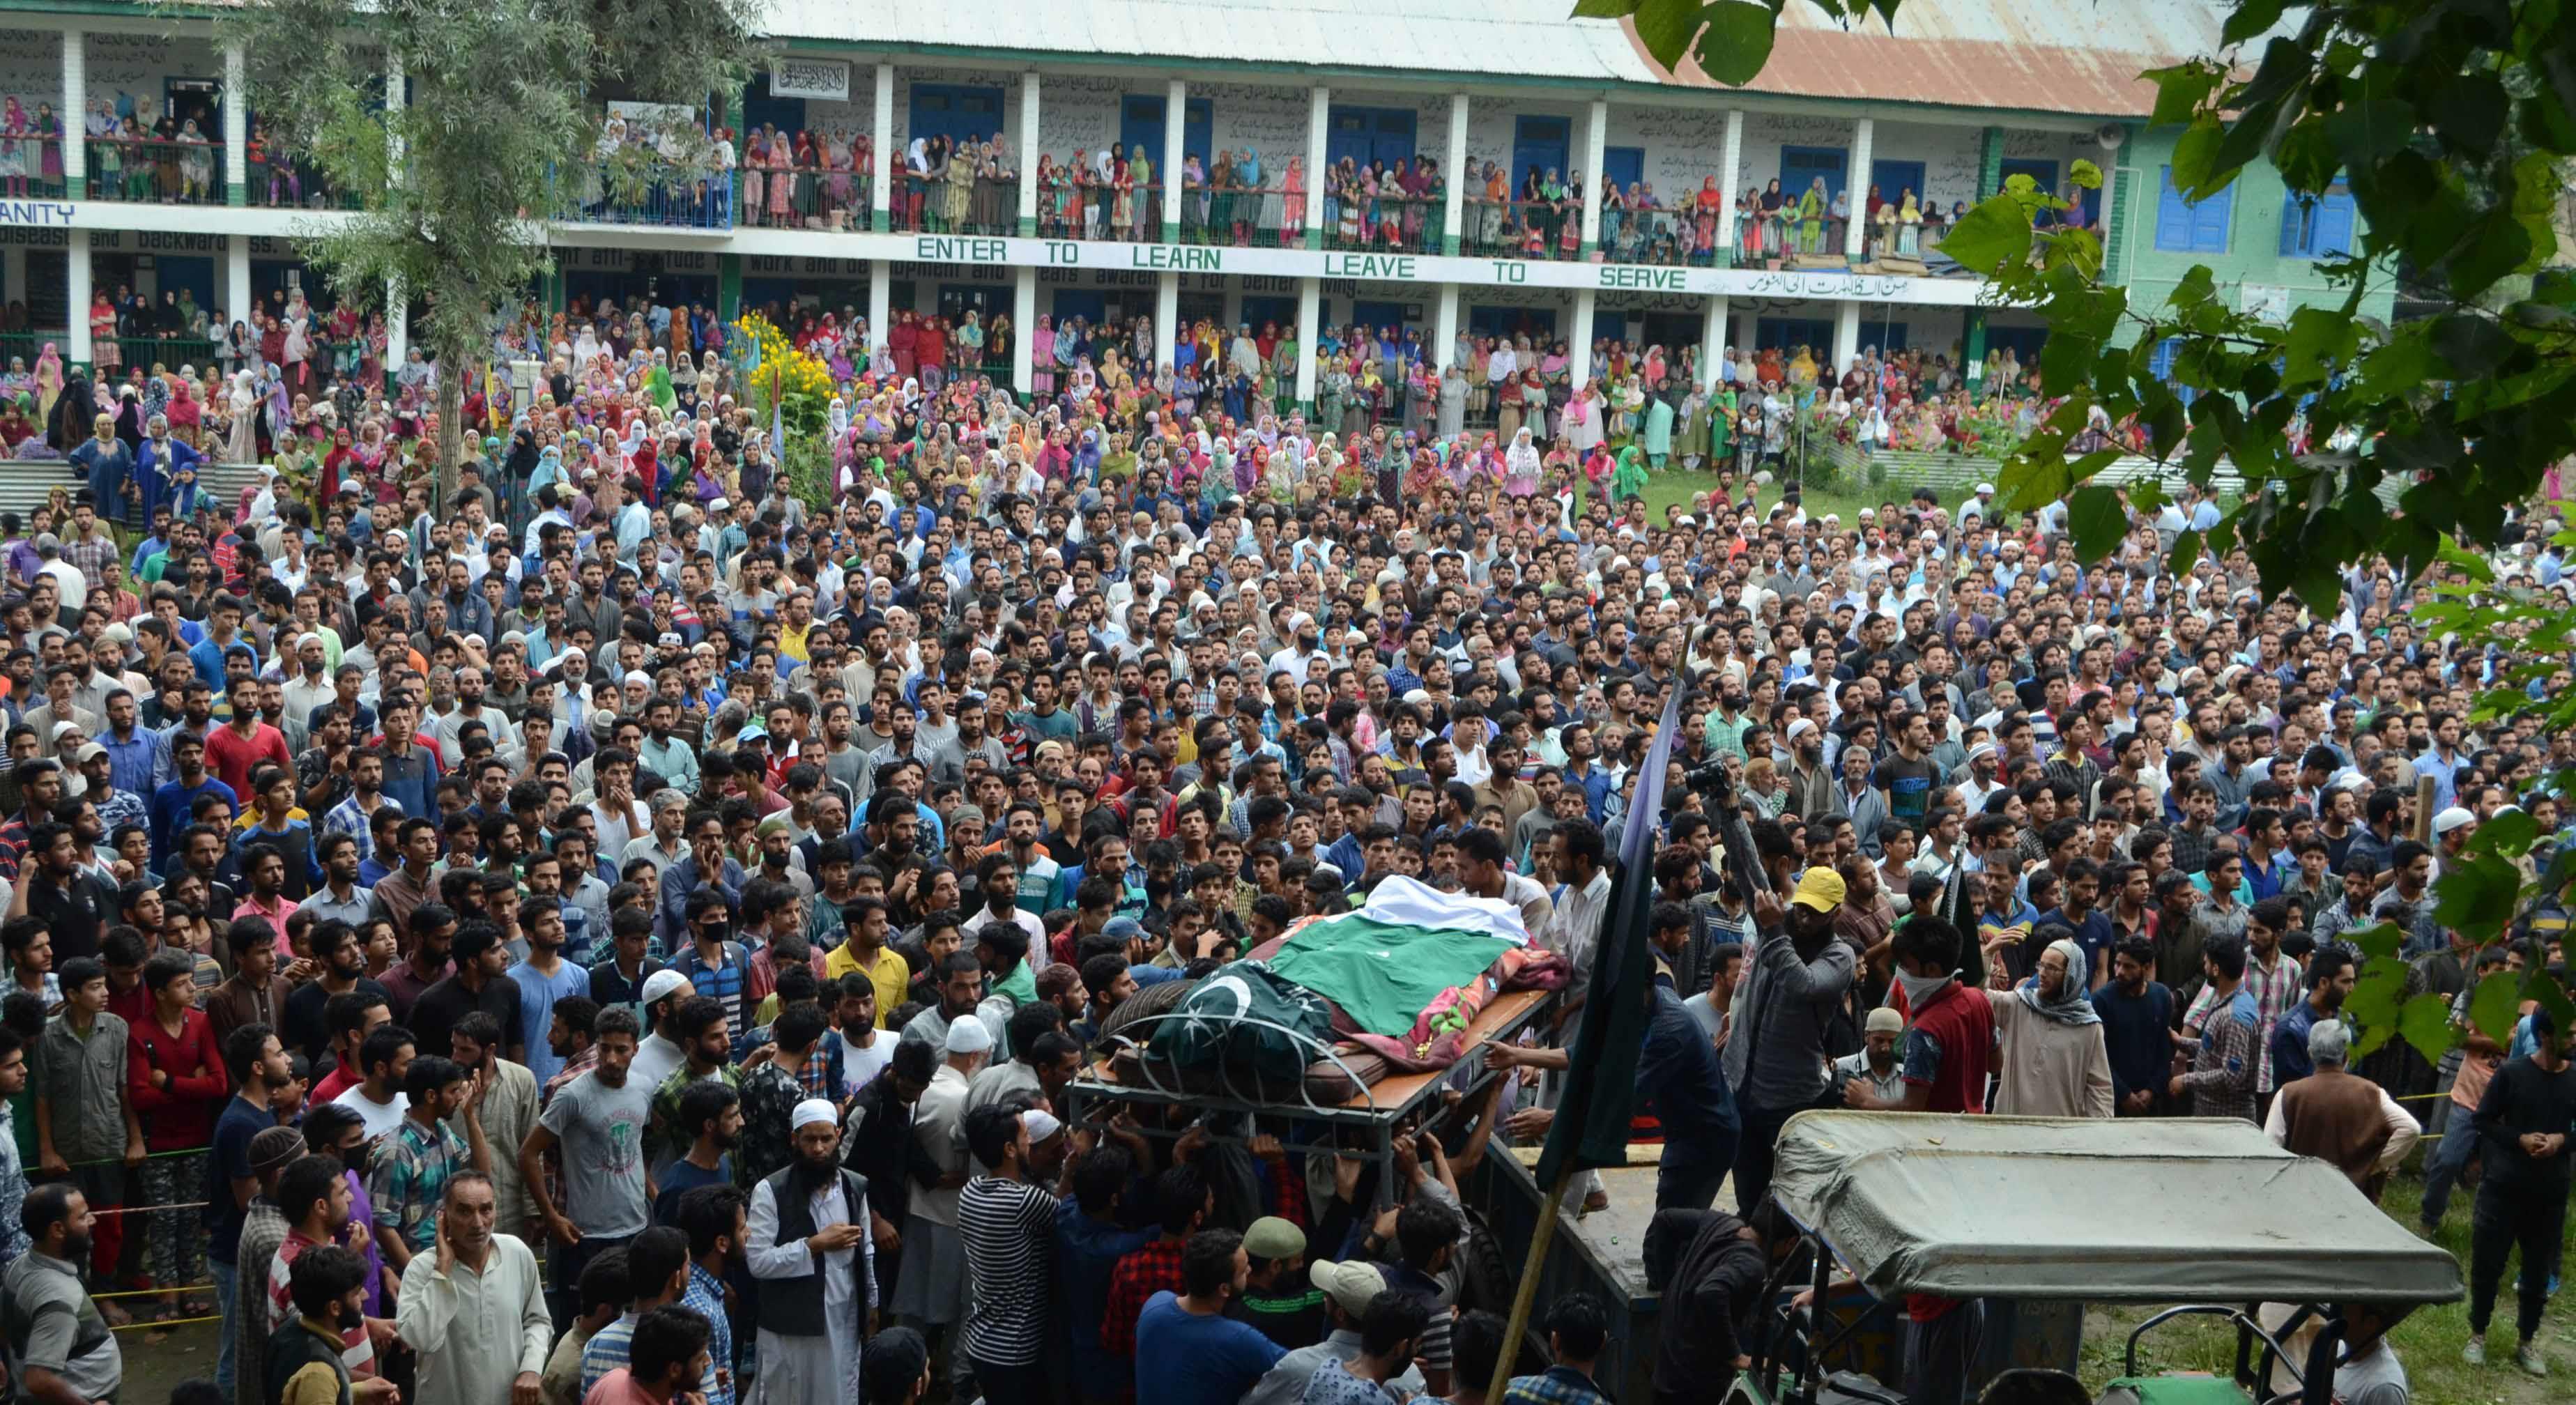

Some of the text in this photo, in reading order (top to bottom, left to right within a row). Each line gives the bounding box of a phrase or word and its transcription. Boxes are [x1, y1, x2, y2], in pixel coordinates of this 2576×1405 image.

[0, 201, 75, 224] ANITY
[90, 231, 119, 247] and
[751, 256, 792, 272] work
[917, 237, 1007, 261] ENTER
[1045, 242, 1079, 263] TO
[1133, 245, 1222, 270] LEARN
[1325, 254, 1416, 278] LEAVE
[1492, 261, 1526, 283] TO
[1600, 266, 1687, 291] SERVE
